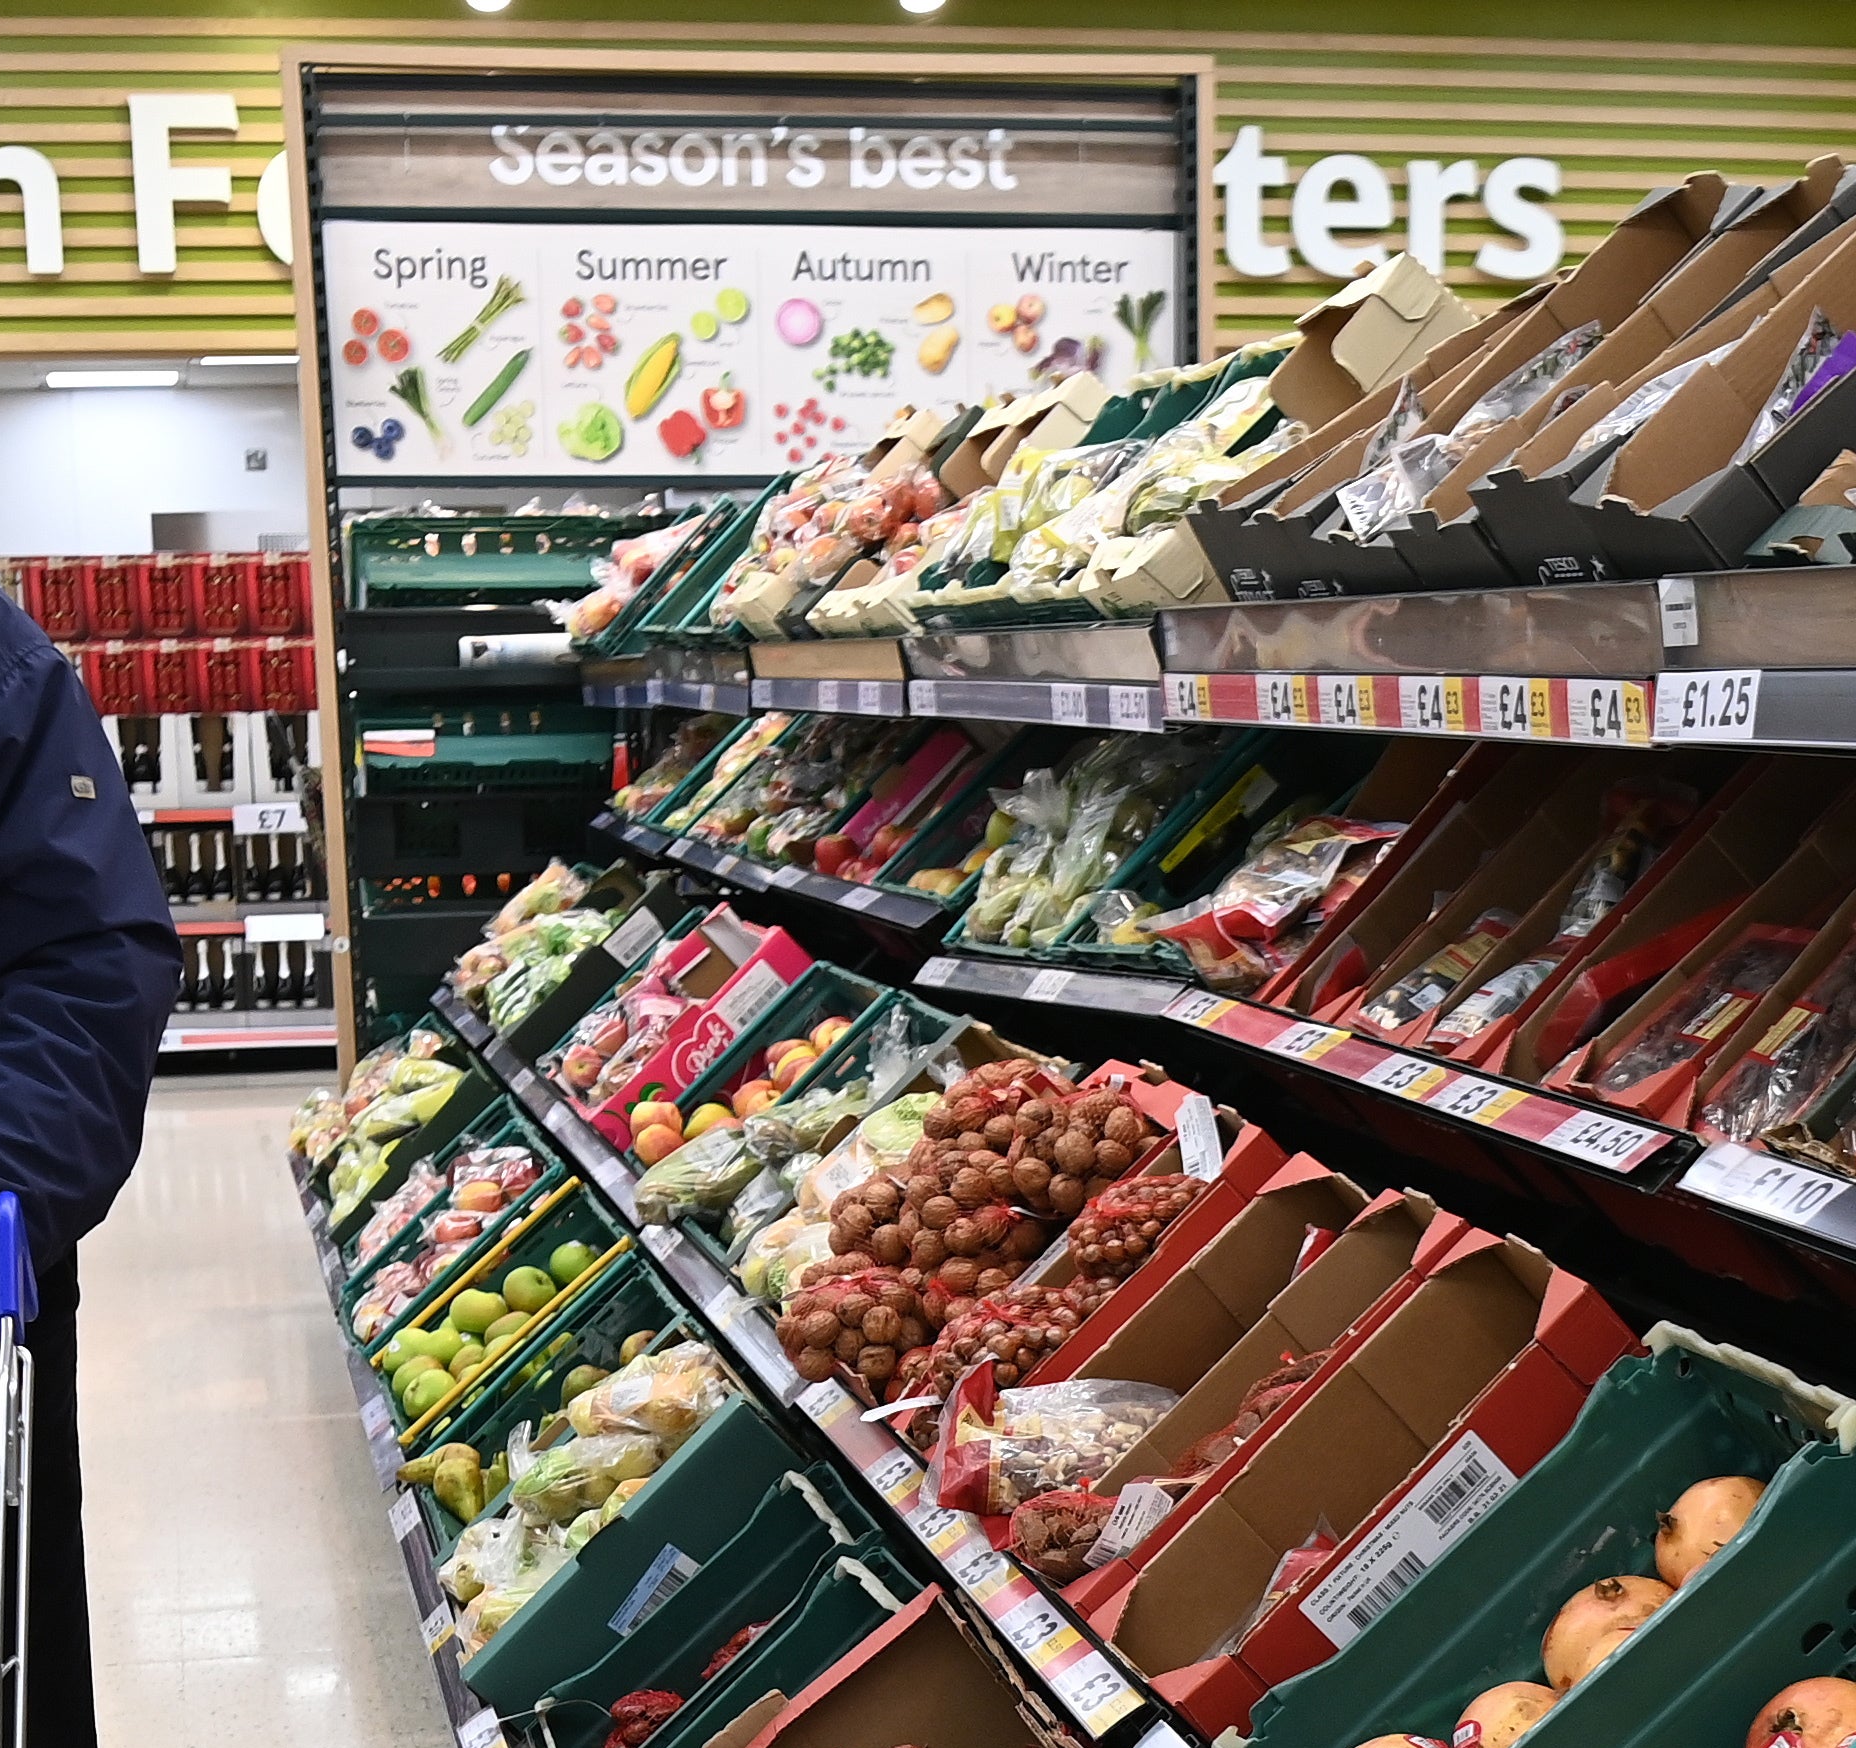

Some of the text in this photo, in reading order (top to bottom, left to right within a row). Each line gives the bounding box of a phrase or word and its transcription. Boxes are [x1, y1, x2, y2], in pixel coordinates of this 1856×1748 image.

[488, 125, 1020, 191] Season's best
[127, 93, 294, 273] F
[373, 247, 489, 286] Spring
[575, 249, 728, 282] Summer
[792, 251, 932, 283] Autumn
[1012, 252, 1129, 284] Winter
[1177, 680, 1196, 717] £4
[1270, 681, 1292, 721] £4
[1334, 684, 1357, 723] £4
[1417, 685, 1443, 729] £4
[1499, 684, 1527, 732] £4
[1590, 688, 1622, 739] £4
[1681, 676, 1753, 728] £1.25
[257, 808, 287, 830] £7
[1291, 1027, 1318, 1053] £3
[1382, 1061, 1427, 1091] £3
[1447, 1083, 1497, 1115] £3
[1569, 1120, 1646, 1158] £4.50
[1752, 1166, 1834, 1216] £1.10
[876, 1460, 912, 1492] £3
[917, 1507, 955, 1538] £3
[956, 1550, 1000, 1585] £3
[1310, 1500, 1414, 1607] CLASS CHRISTMAS NUTS
[1375, 1541, 1393, 1559] 225g
[1010, 1611, 1059, 1650] £3
[1070, 1672, 1122, 1713] £3
